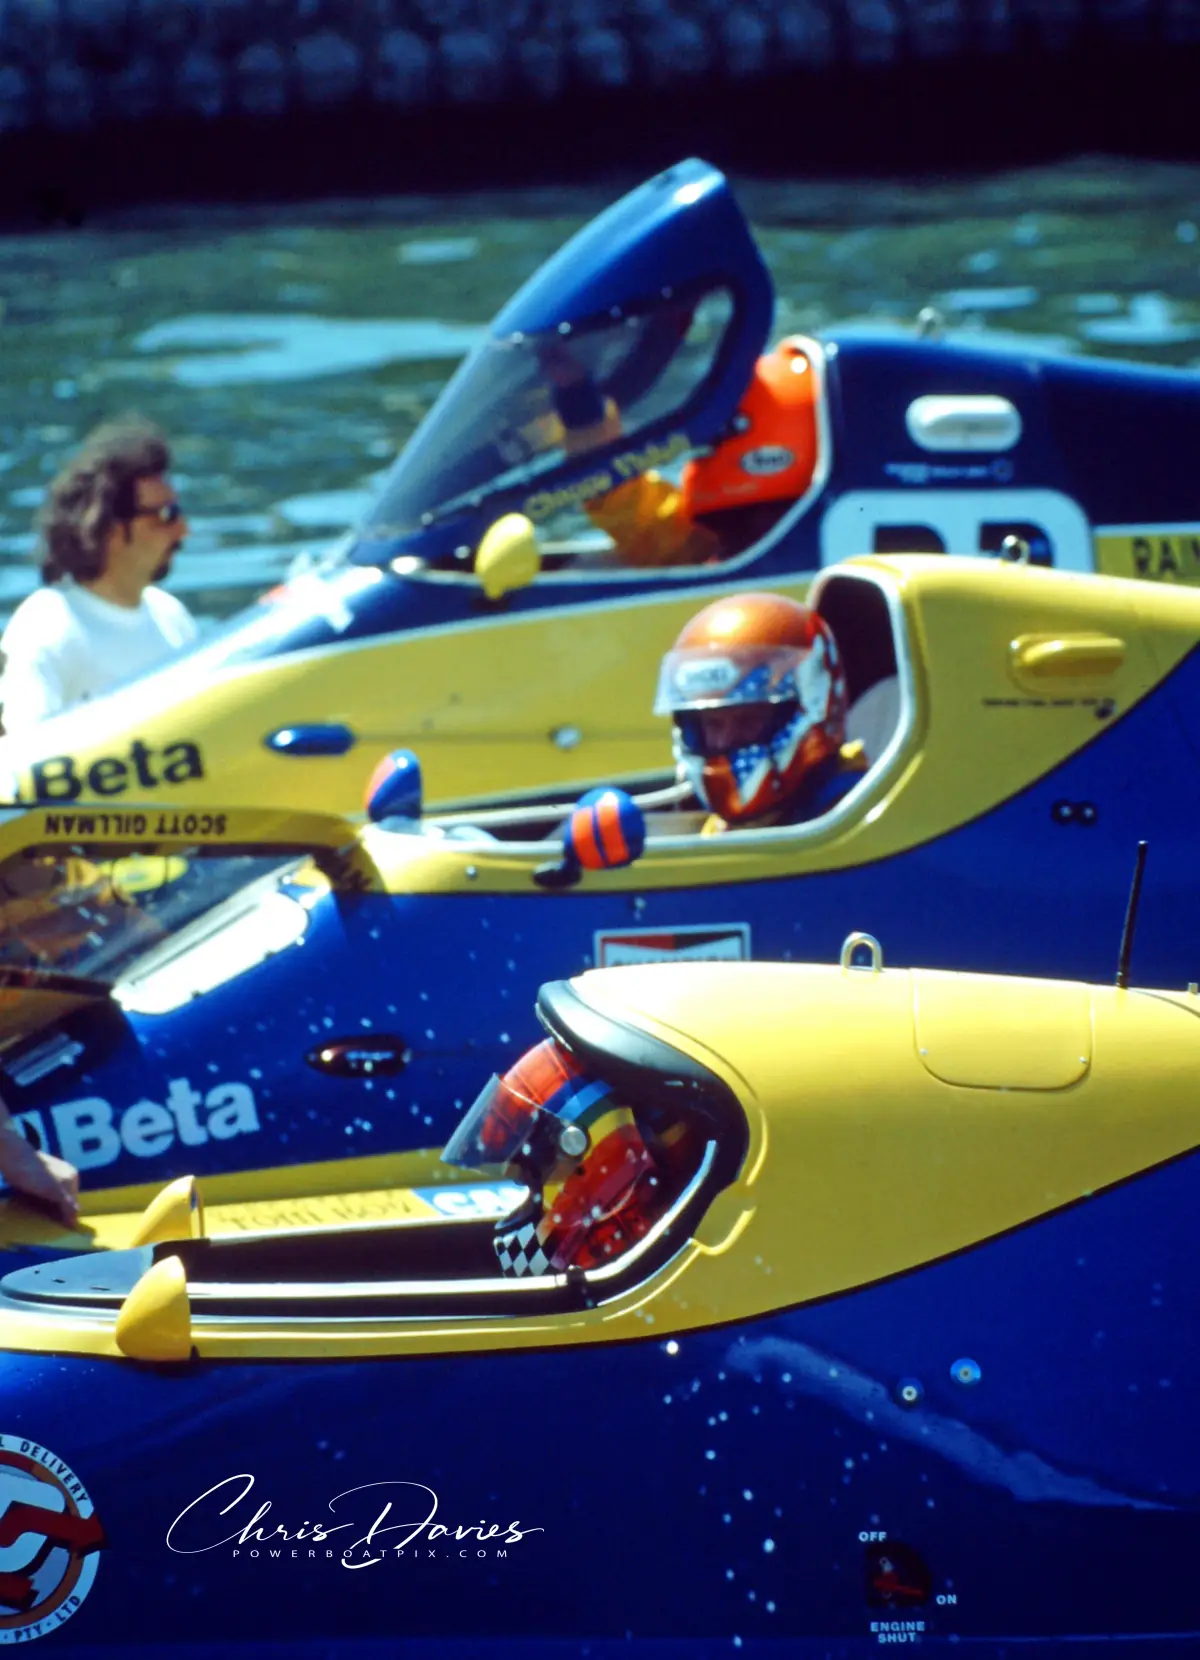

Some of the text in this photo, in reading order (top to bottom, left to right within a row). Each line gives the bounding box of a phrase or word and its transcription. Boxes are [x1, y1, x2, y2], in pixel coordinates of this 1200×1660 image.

[31, 739, 205, 804] Beta
[45, 814, 228, 835] SCOTT GILLMAN
[51, 1077, 261, 1172] Beta
[19, 1440, 89, 1502] DELIVERY
[858, 1531, 887, 1542] OFF
[936, 1594, 957, 1605] ON
[14, 1595, 81, 1643] PTY LTD
[870, 1621, 925, 1632] ENGINE
[878, 1632, 916, 1643] SHUT
